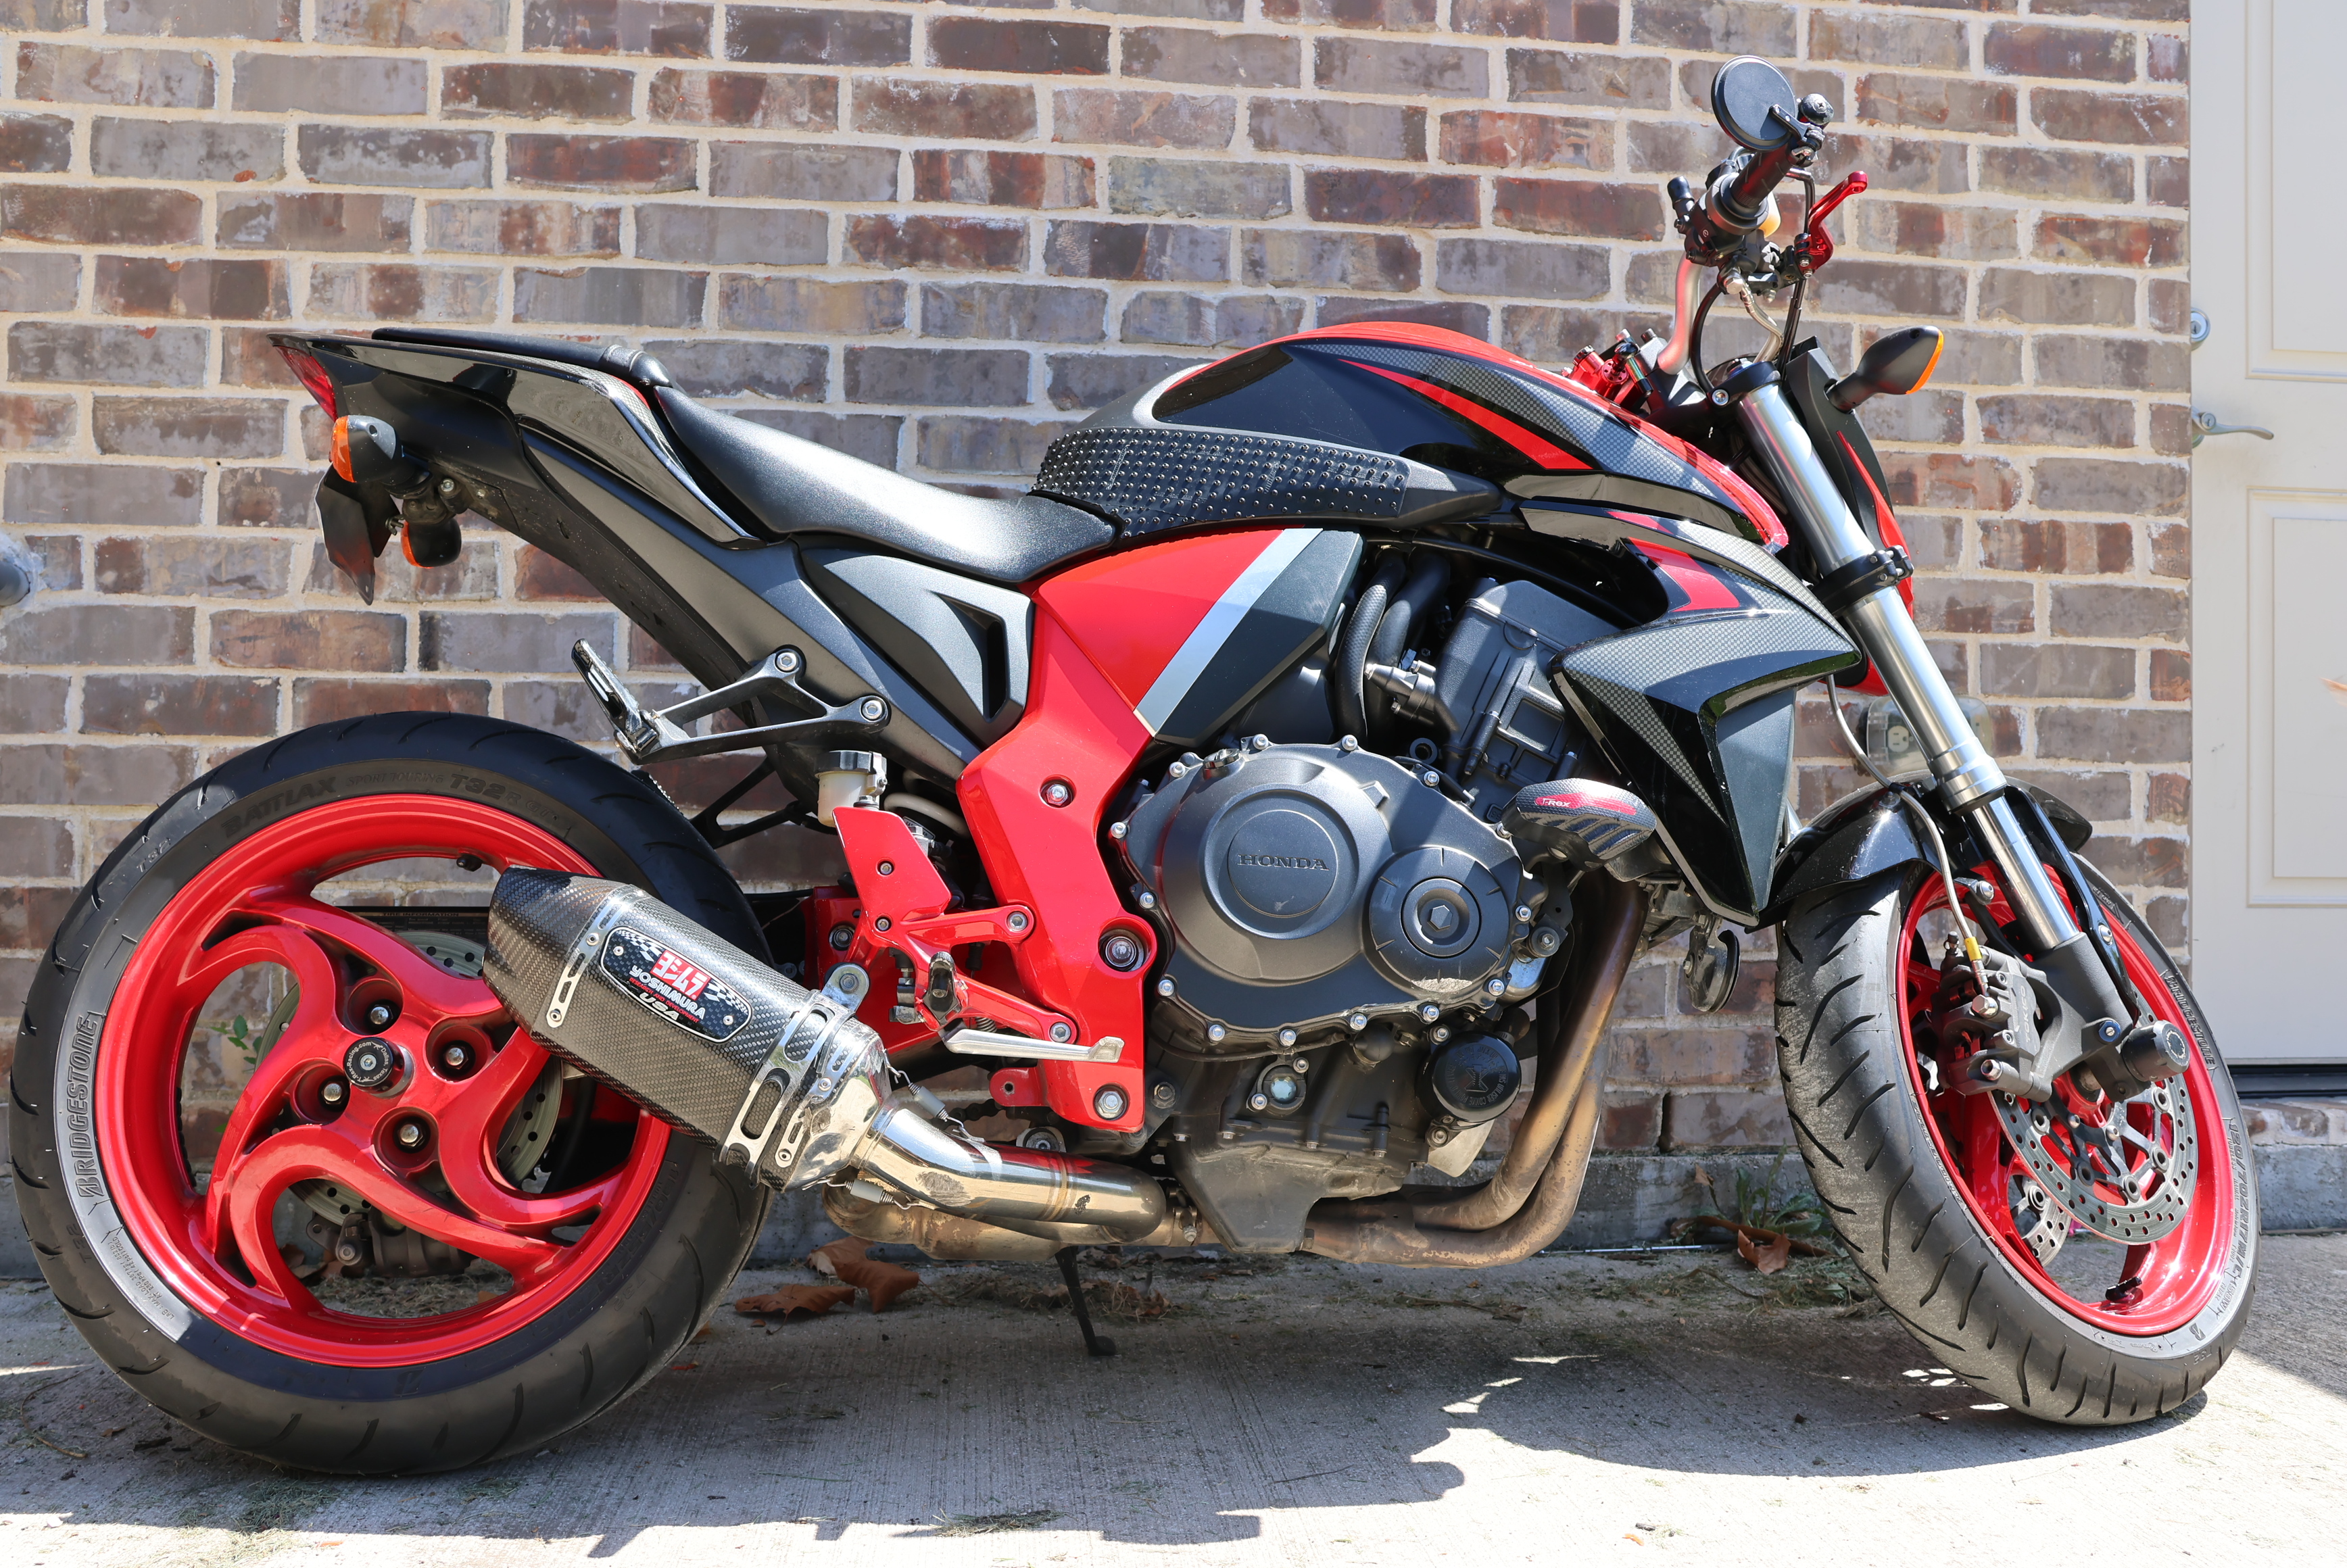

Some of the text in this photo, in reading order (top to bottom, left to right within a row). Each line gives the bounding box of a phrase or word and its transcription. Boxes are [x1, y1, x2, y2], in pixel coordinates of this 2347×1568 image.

[221, 777, 337, 839] BATTLAX
[1238, 854, 1330, 871] HONDA
[629, 965, 706, 1020] YOSHIMURA
[629, 977, 700, 1023] RESEARCH AND DEVELOPMENT
[639, 991, 679, 1020] USA
[2021, 985, 2031, 1043] TOKICO
[2164, 975, 2216, 1065] BRIDGESTONE
[372, 1068, 388, 1081] Texas
[67, 1014, 105, 1198] BRIDGESTONE
